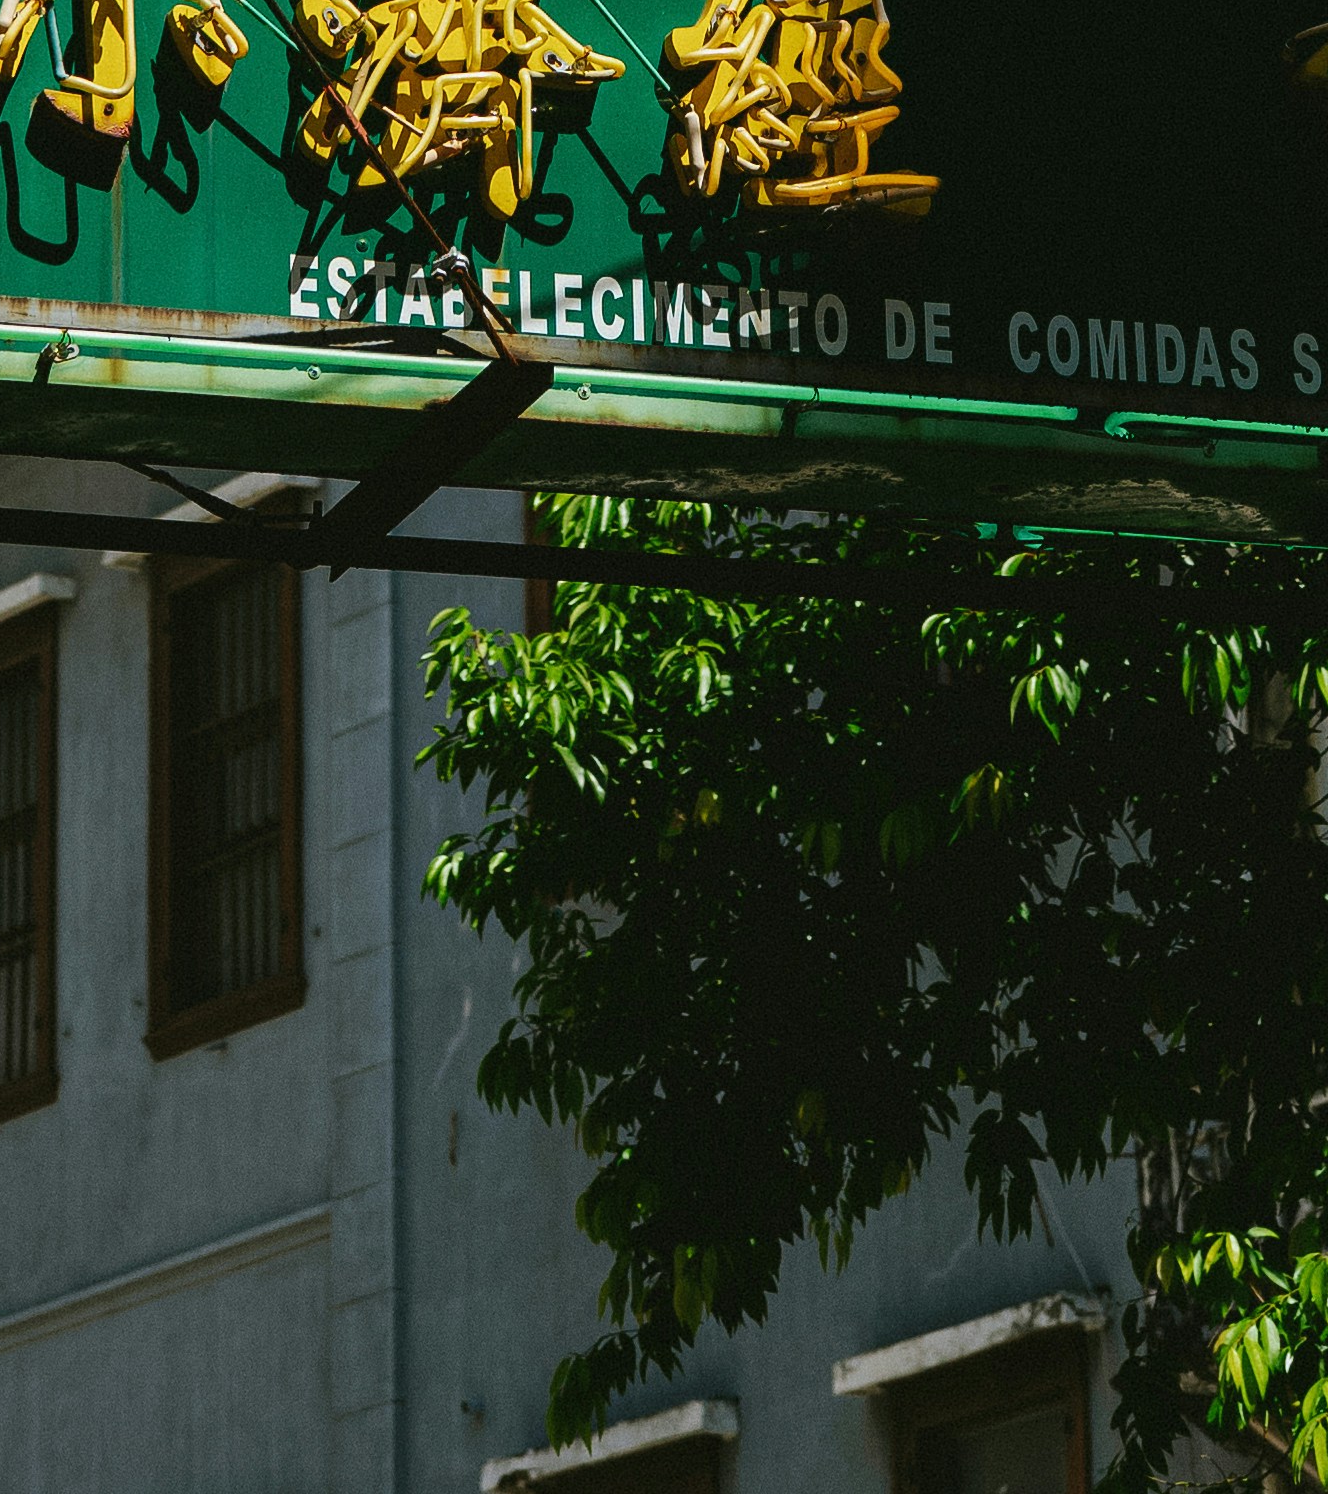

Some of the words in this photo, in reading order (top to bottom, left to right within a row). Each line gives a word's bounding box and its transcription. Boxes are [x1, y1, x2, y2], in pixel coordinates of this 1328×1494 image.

[288, 252, 850, 357] ESTABELECIMENTO
[886, 299, 955, 365] DE
[1007, 310, 1261, 391] COMIDAS
